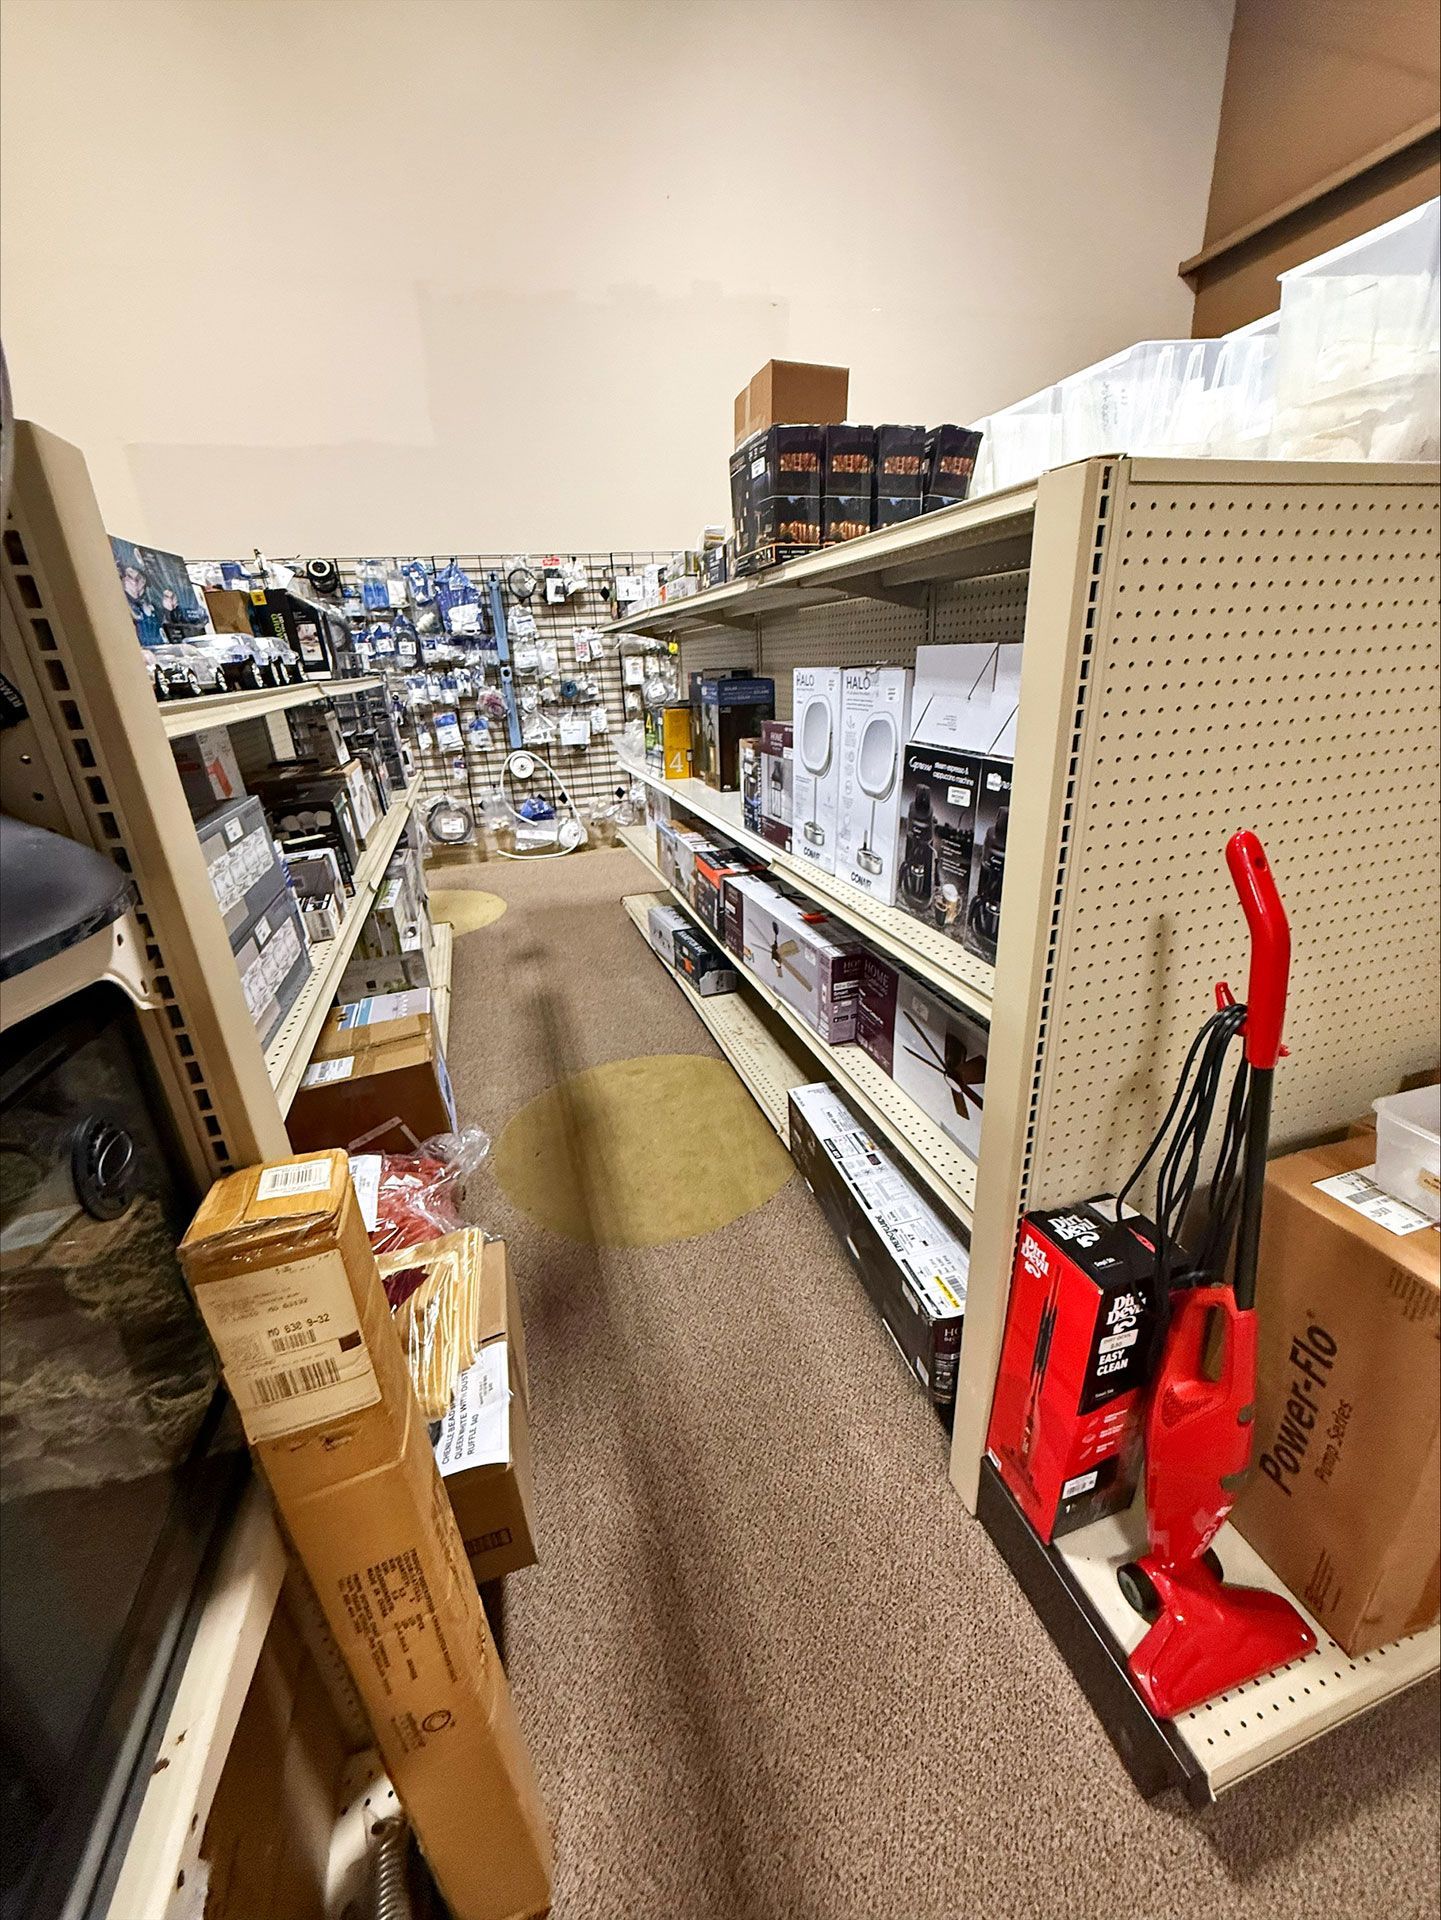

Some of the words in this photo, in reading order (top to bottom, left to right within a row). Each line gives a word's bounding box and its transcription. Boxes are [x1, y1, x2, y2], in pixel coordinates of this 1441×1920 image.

[796, 674, 815, 686] HALO
[846, 676, 871, 690] HALO
[646, 713, 652, 733] 4
[670, 751, 684, 773] 4
[1047, 1214, 1083, 1231] Dirt
[1054, 1218, 1100, 1241] Devil
[1024, 1234, 1047, 1260] Dirt
[1096, 1358, 1129, 1376] CLEAN
[1099, 1349, 1125, 1366] EASY
[1259, 1324, 1338, 1498] Power-Flo
[1327, 1399, 1353, 1447] Series
[454, 1435, 464, 1460] QUEEN
[467, 1427, 477, 1455] RUFFLE
